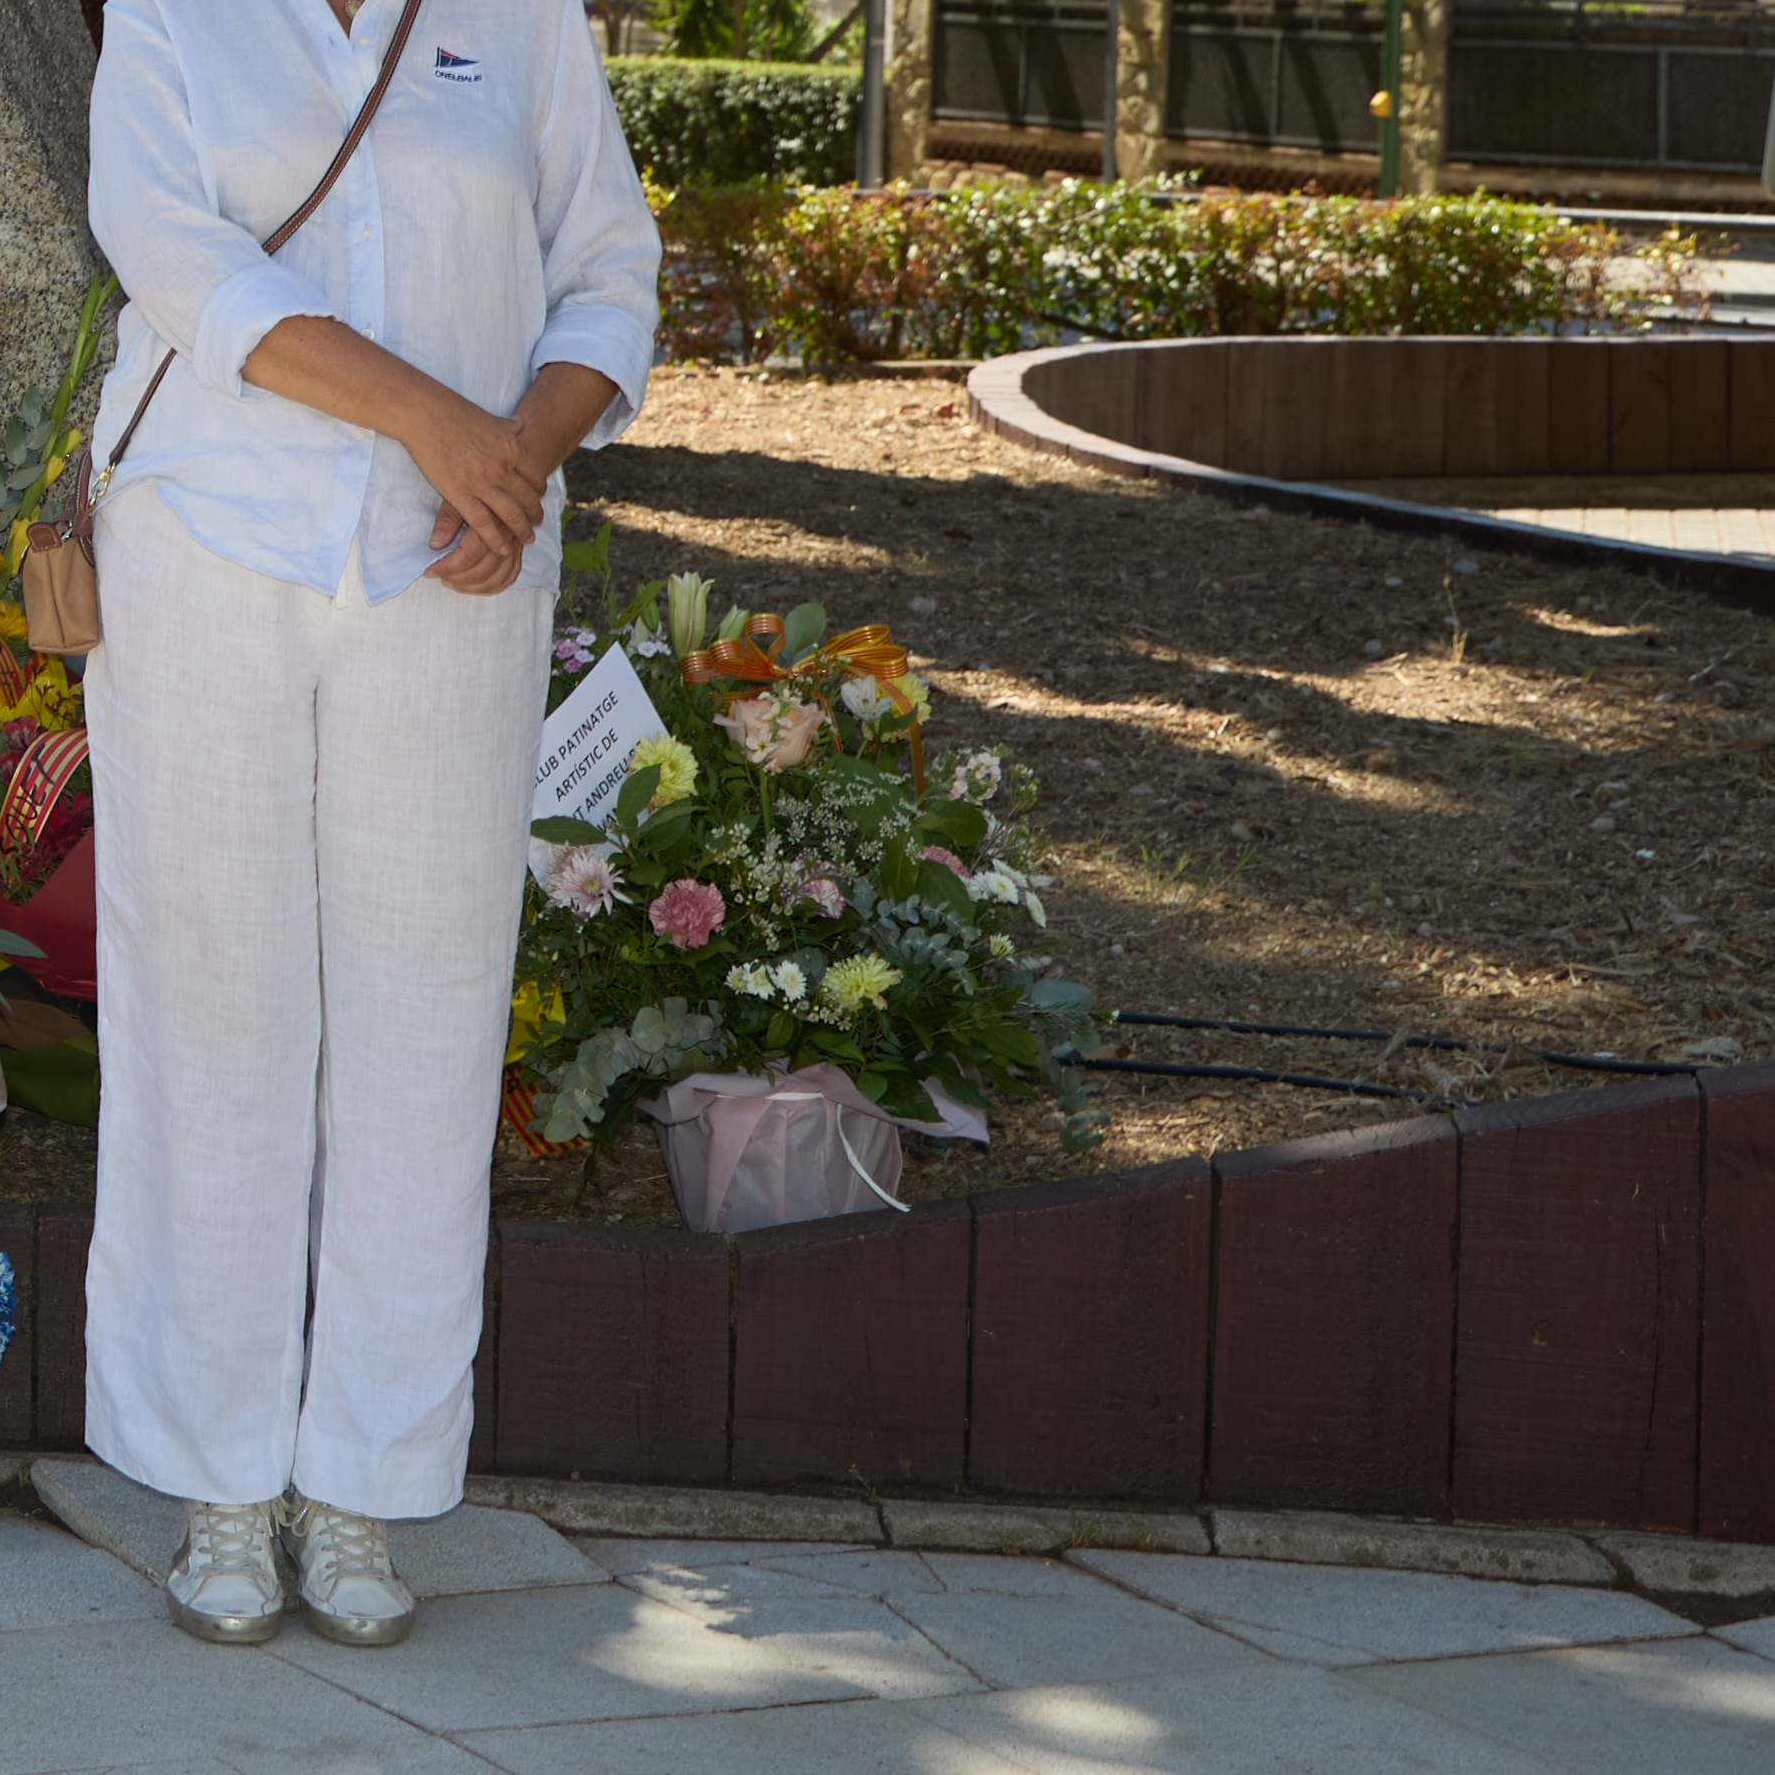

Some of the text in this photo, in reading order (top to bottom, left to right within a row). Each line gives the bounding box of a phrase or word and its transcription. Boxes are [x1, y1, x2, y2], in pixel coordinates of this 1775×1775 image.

[534, 754, 560, 789] LUB
[558, 691, 619, 761] PATINATGE
[555, 745, 604, 803] ARTÍSTIC
[602, 728, 619, 753] DE
[584, 758, 629, 813] ANDREU
